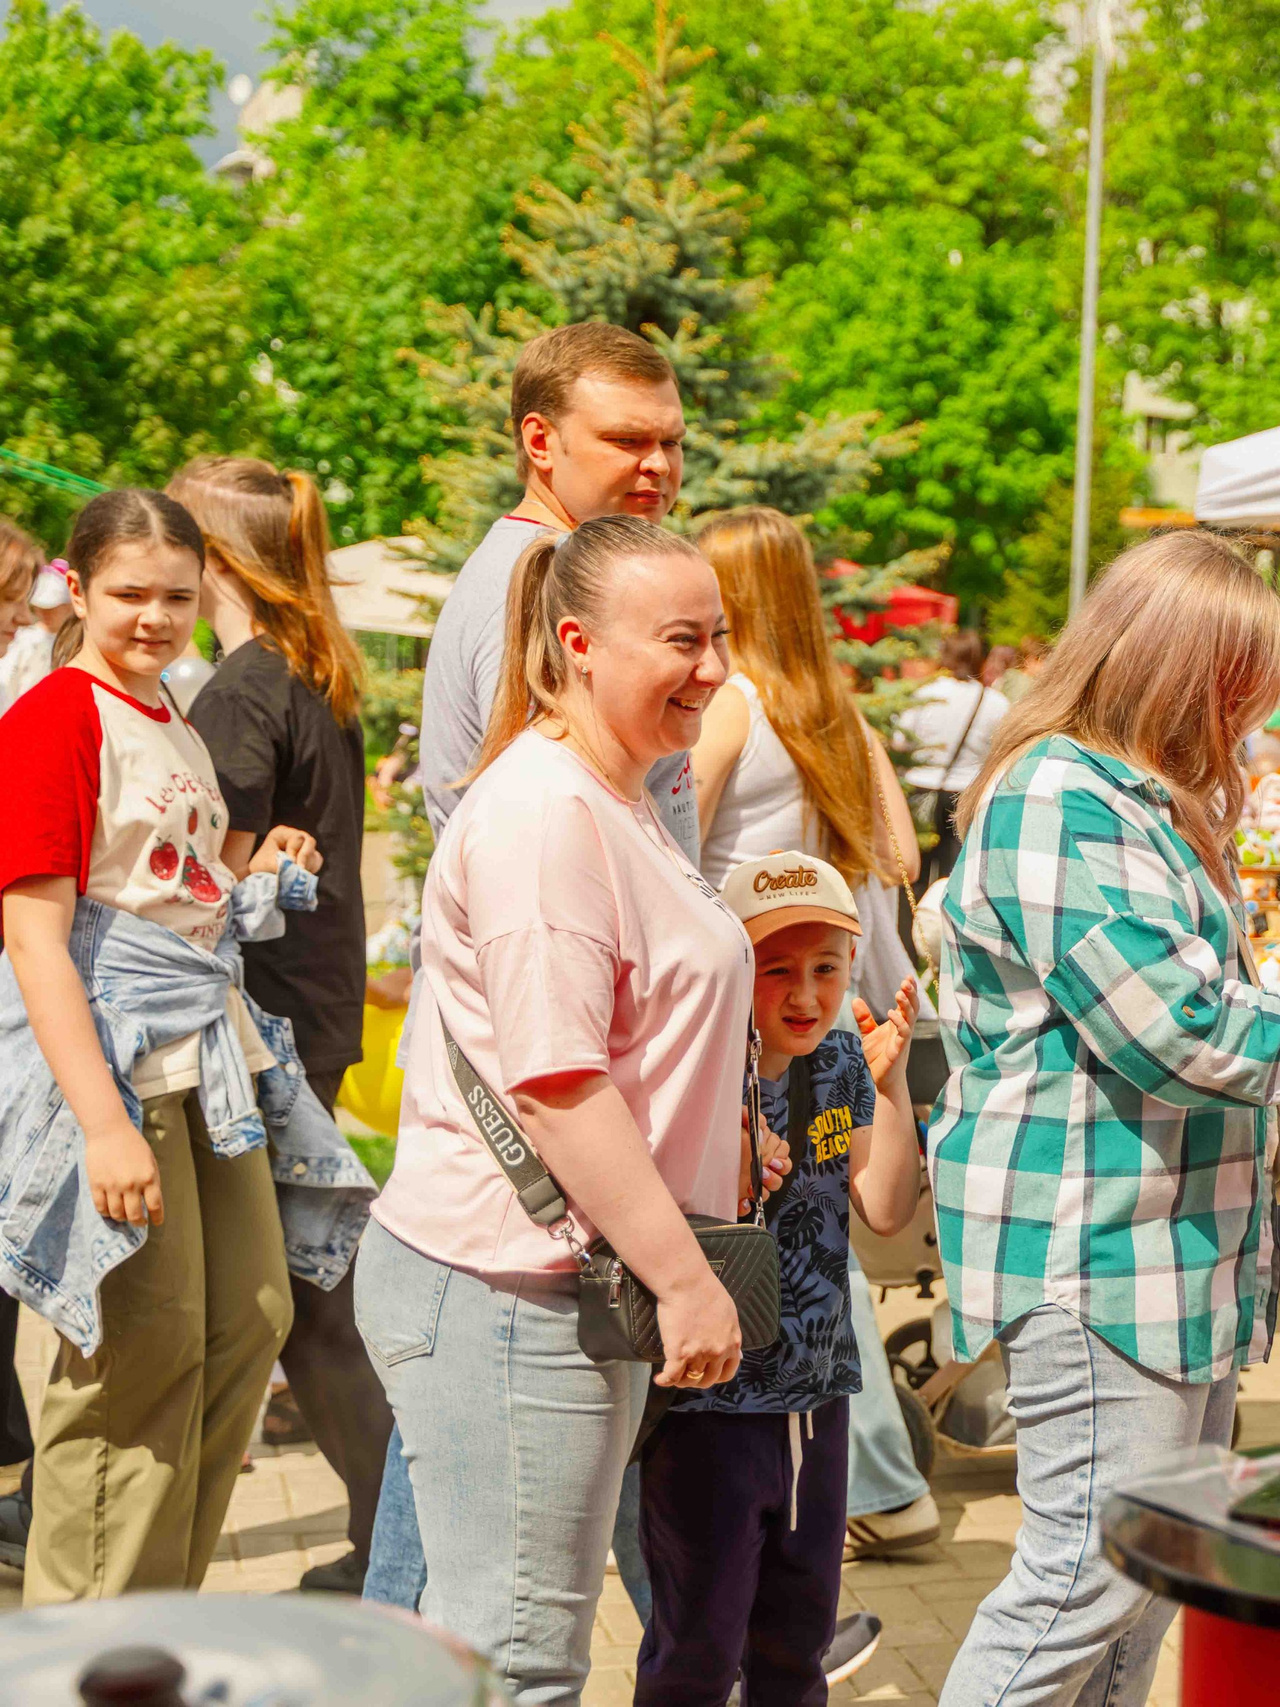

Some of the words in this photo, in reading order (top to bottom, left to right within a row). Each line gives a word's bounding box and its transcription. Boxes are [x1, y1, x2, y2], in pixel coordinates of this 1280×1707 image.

[753, 865, 817, 893] Create
[468, 1084, 526, 1166] GUESS
[807, 1105, 853, 1145] SOUTH
